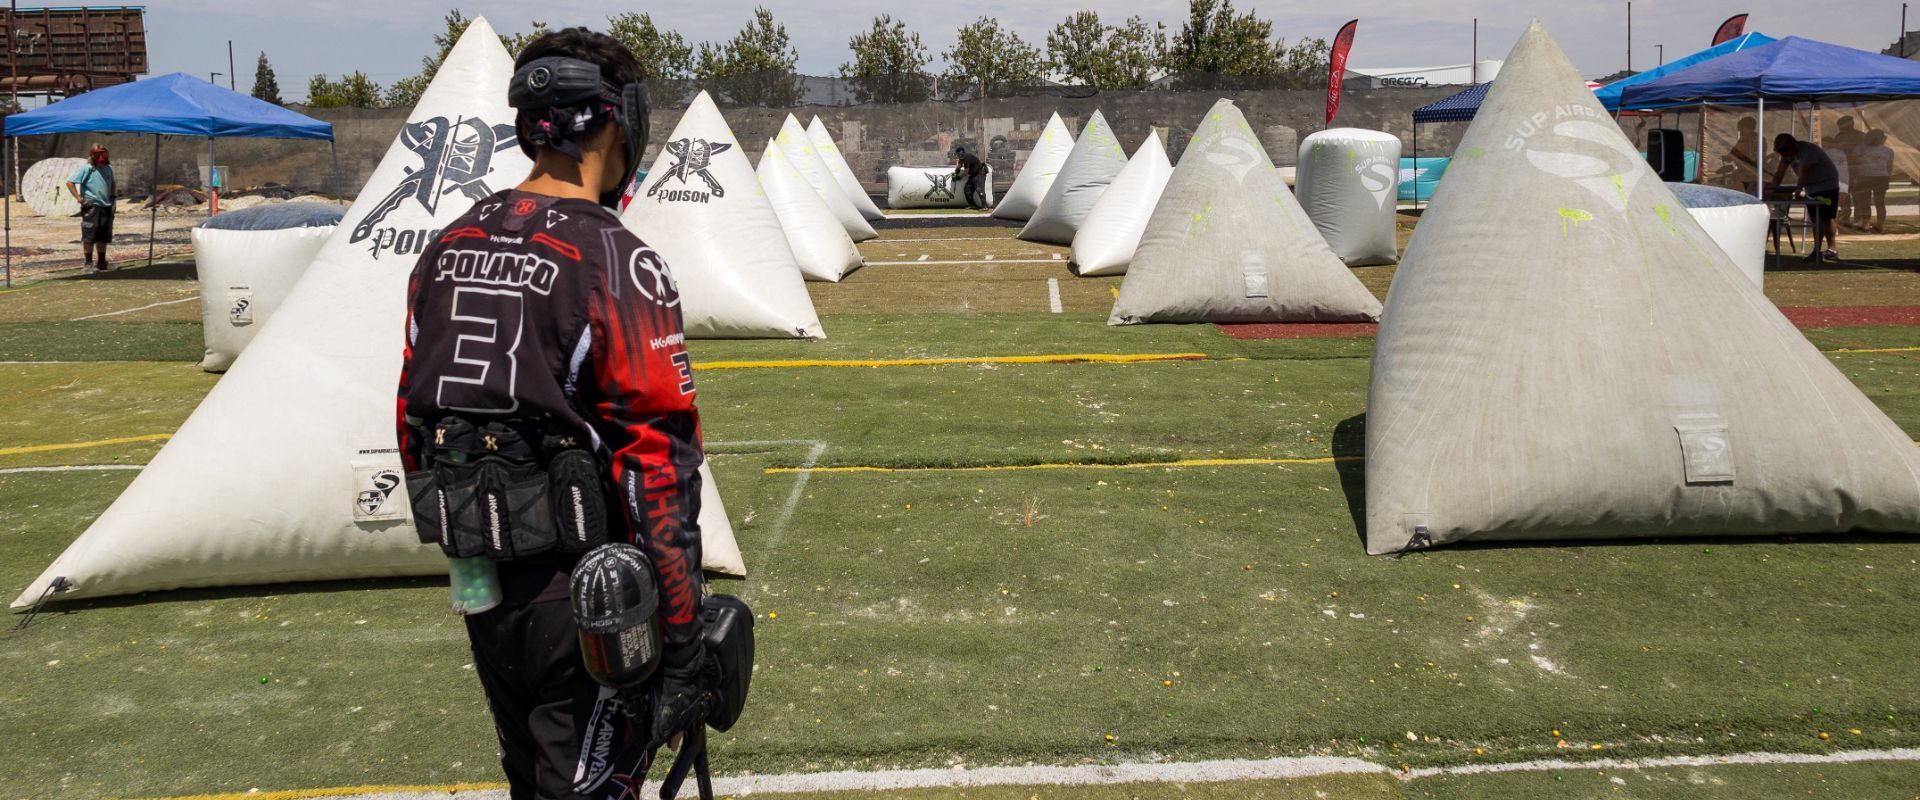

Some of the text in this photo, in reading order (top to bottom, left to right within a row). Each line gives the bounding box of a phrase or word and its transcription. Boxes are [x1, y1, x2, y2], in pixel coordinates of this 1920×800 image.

[656, 189, 710, 204] POISON
[368, 227, 441, 260] POIS
[437, 286, 523, 413] 3
[670, 351, 696, 395] 3
